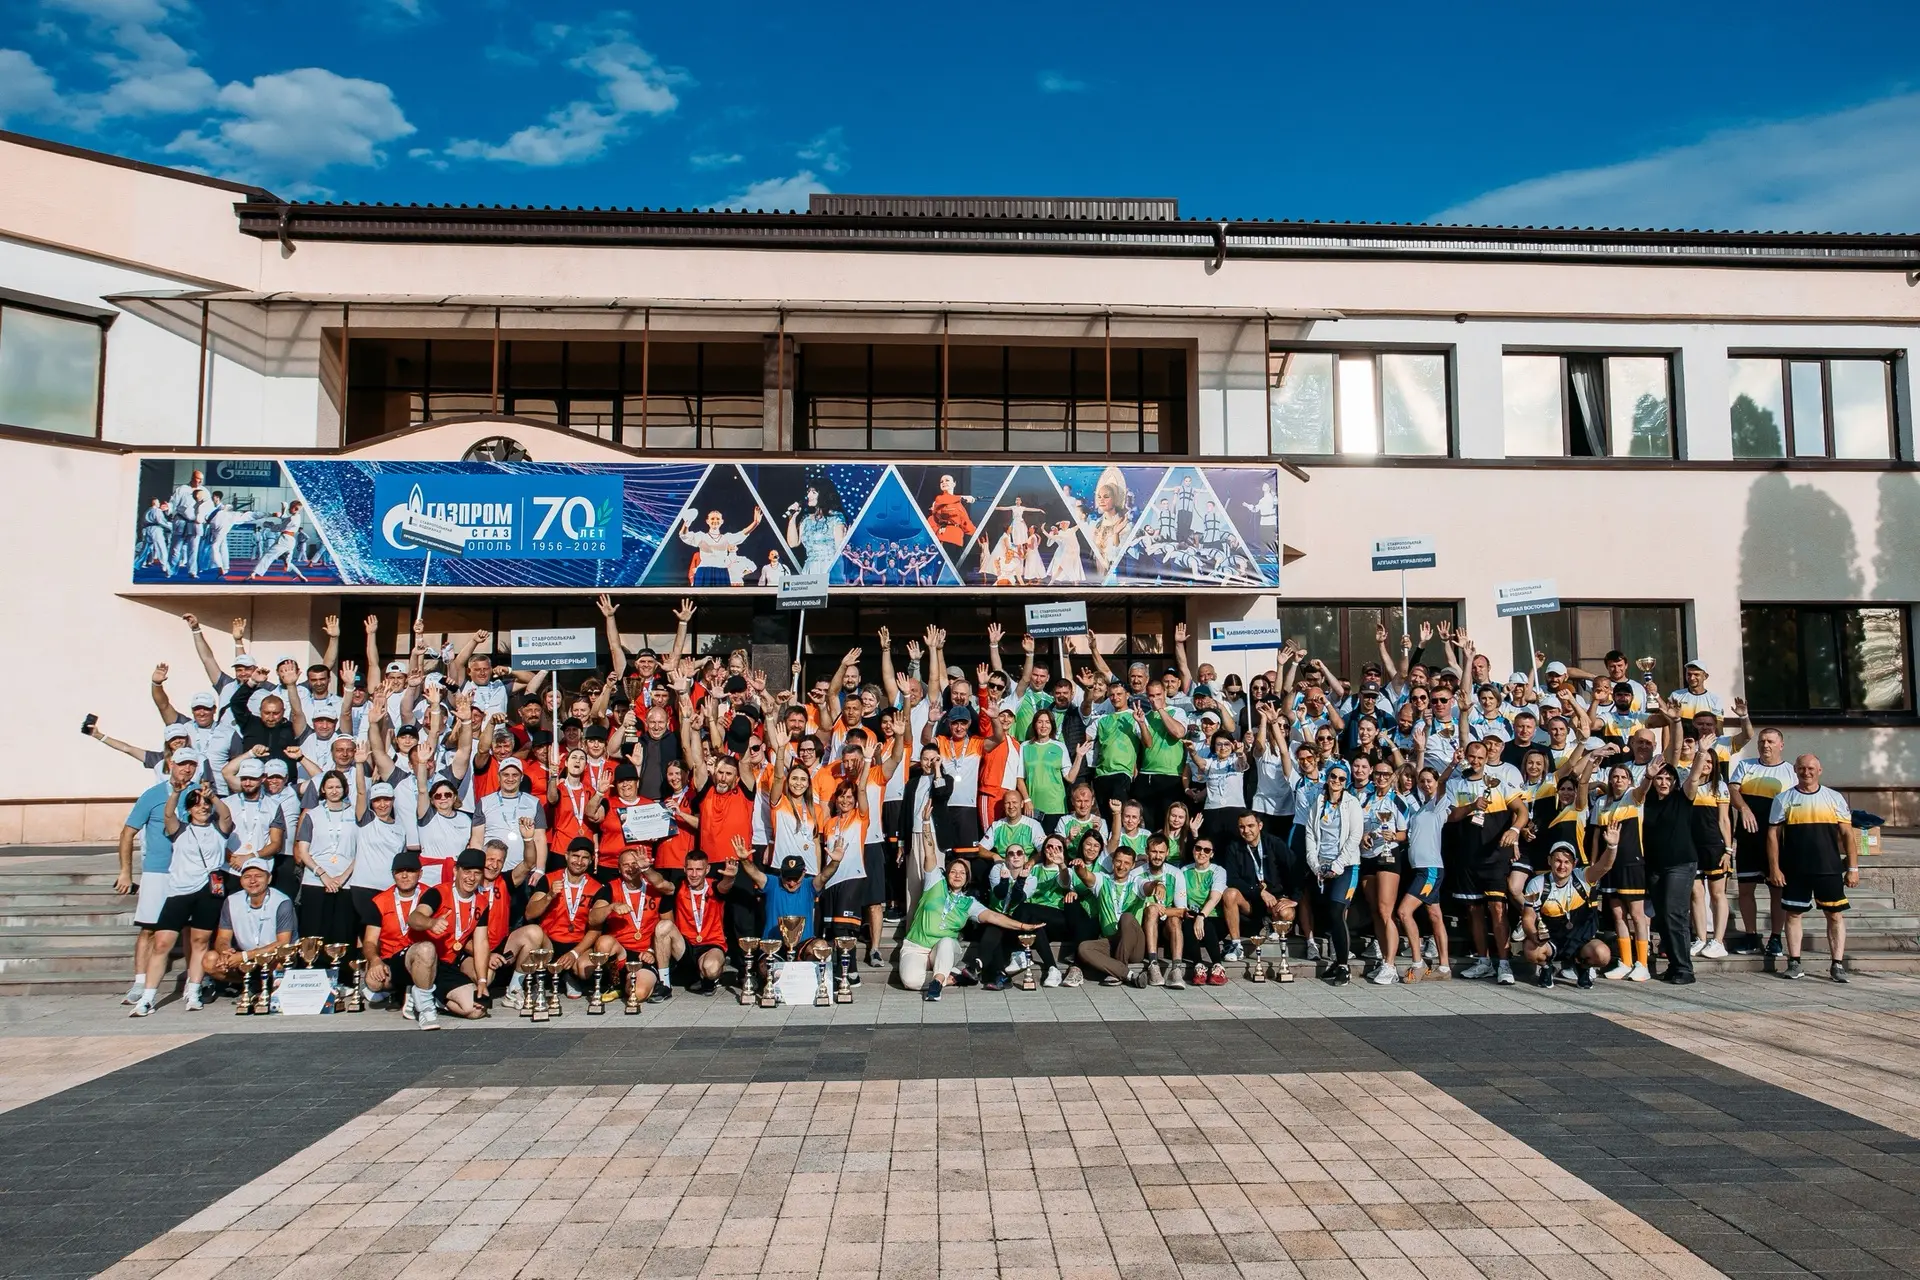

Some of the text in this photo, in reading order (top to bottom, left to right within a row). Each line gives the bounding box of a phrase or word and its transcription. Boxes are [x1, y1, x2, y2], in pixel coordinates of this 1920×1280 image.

[234, 461, 271, 470] ГАЗПРОМ
[427, 503, 512, 525] ГАЗПРОМ
[532, 496, 595, 540] 70
[471, 529, 510, 538] СГАЗ
[580, 529, 604, 538] ЛЕТ
[468, 541, 511, 551] ОПОЛЬ
[532, 541, 606, 551] 1956–2026
[1400, 557, 1432, 565] УПРАВЛЕНИЯ
[801, 598, 821, 606] ЮЖНЫЙ
[1524, 602, 1555, 611] ВОСТОЧНЫЙ
[1050, 625, 1086, 633] ЦЕНТРАЛЬНЫЙ
[1226, 628, 1279, 636] КАВМИНВОДОКАНАЛ
[531, 634, 576, 642] СТАВРОПОЛЬКРАЙ
[550, 657, 588, 665] СЕВЕРНЫЙ
[632, 812, 661, 821] СЕРТИФИКАТ
